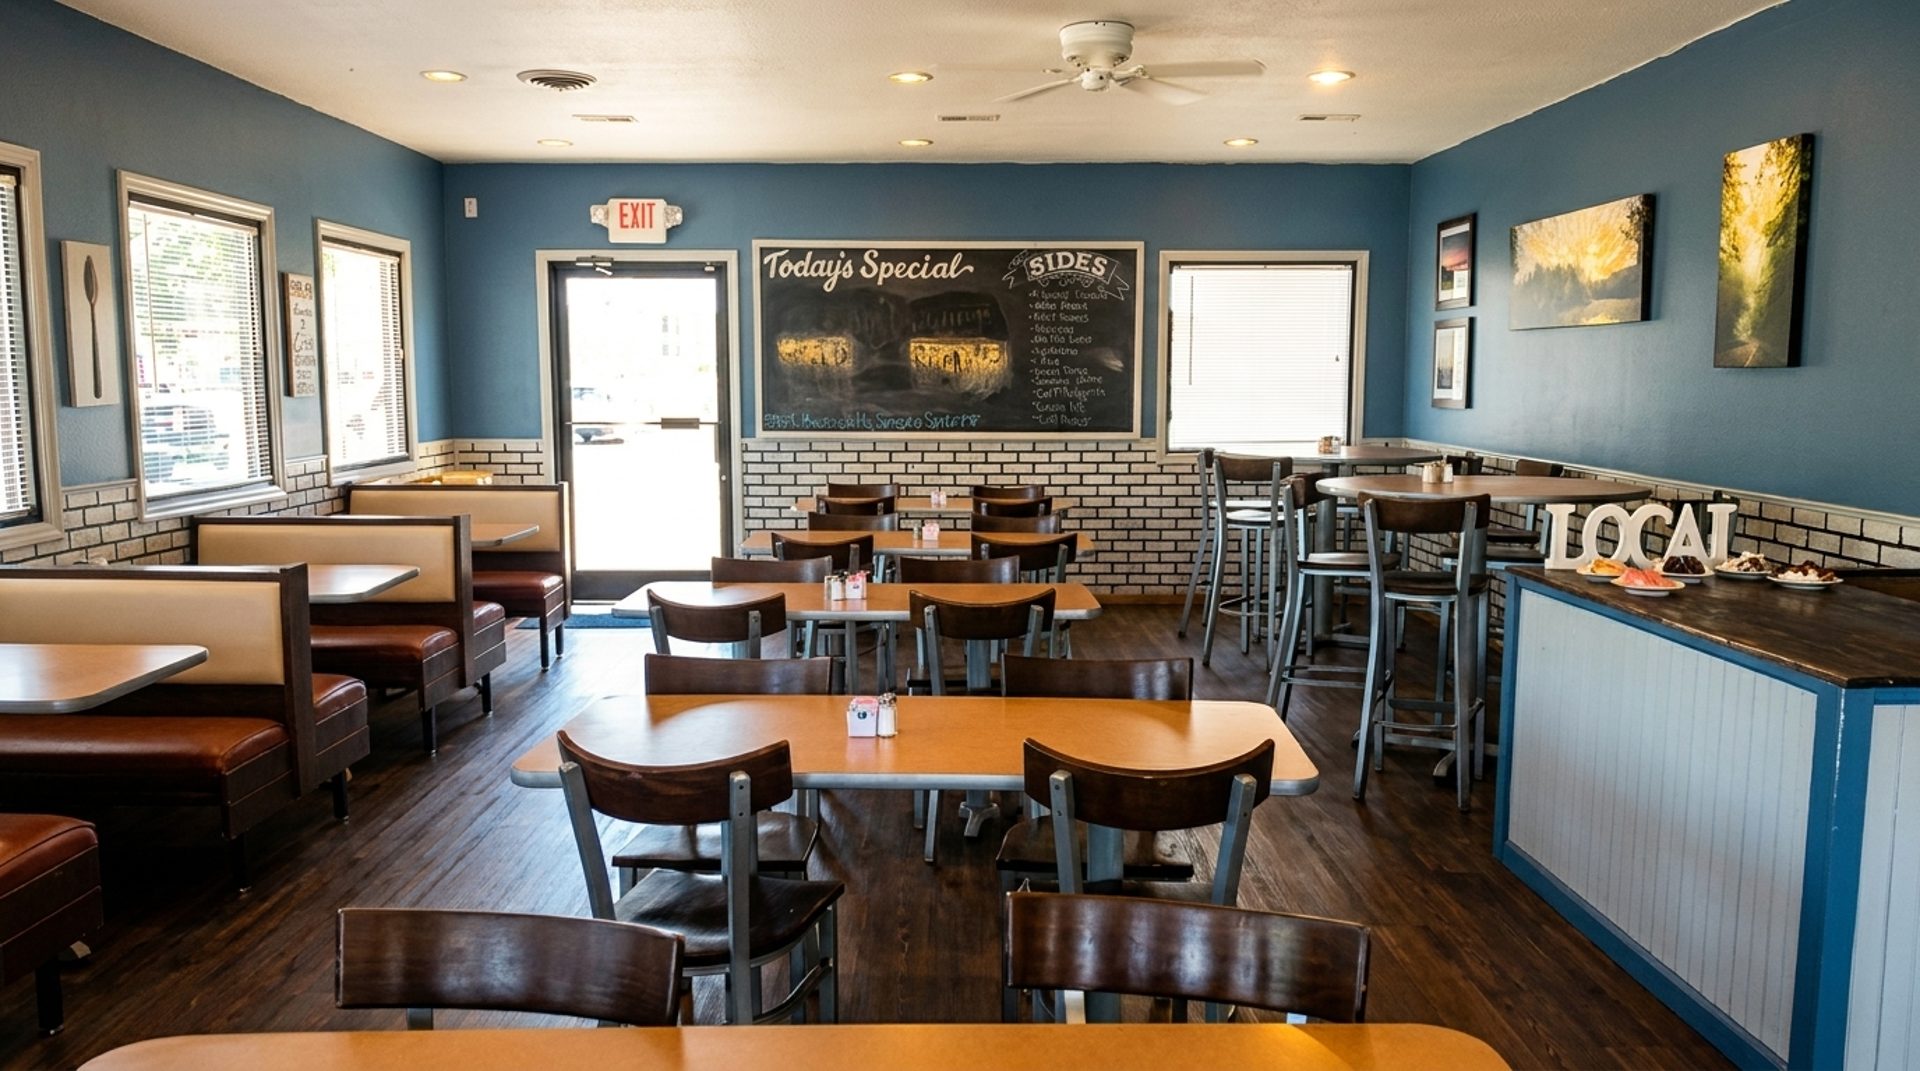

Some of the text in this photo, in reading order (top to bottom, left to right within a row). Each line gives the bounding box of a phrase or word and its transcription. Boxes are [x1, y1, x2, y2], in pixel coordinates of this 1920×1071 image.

[619, 202, 656, 229] EXIT
[763, 249, 974, 292] Today's Special
[1029, 251, 1108, 277] SIDES
